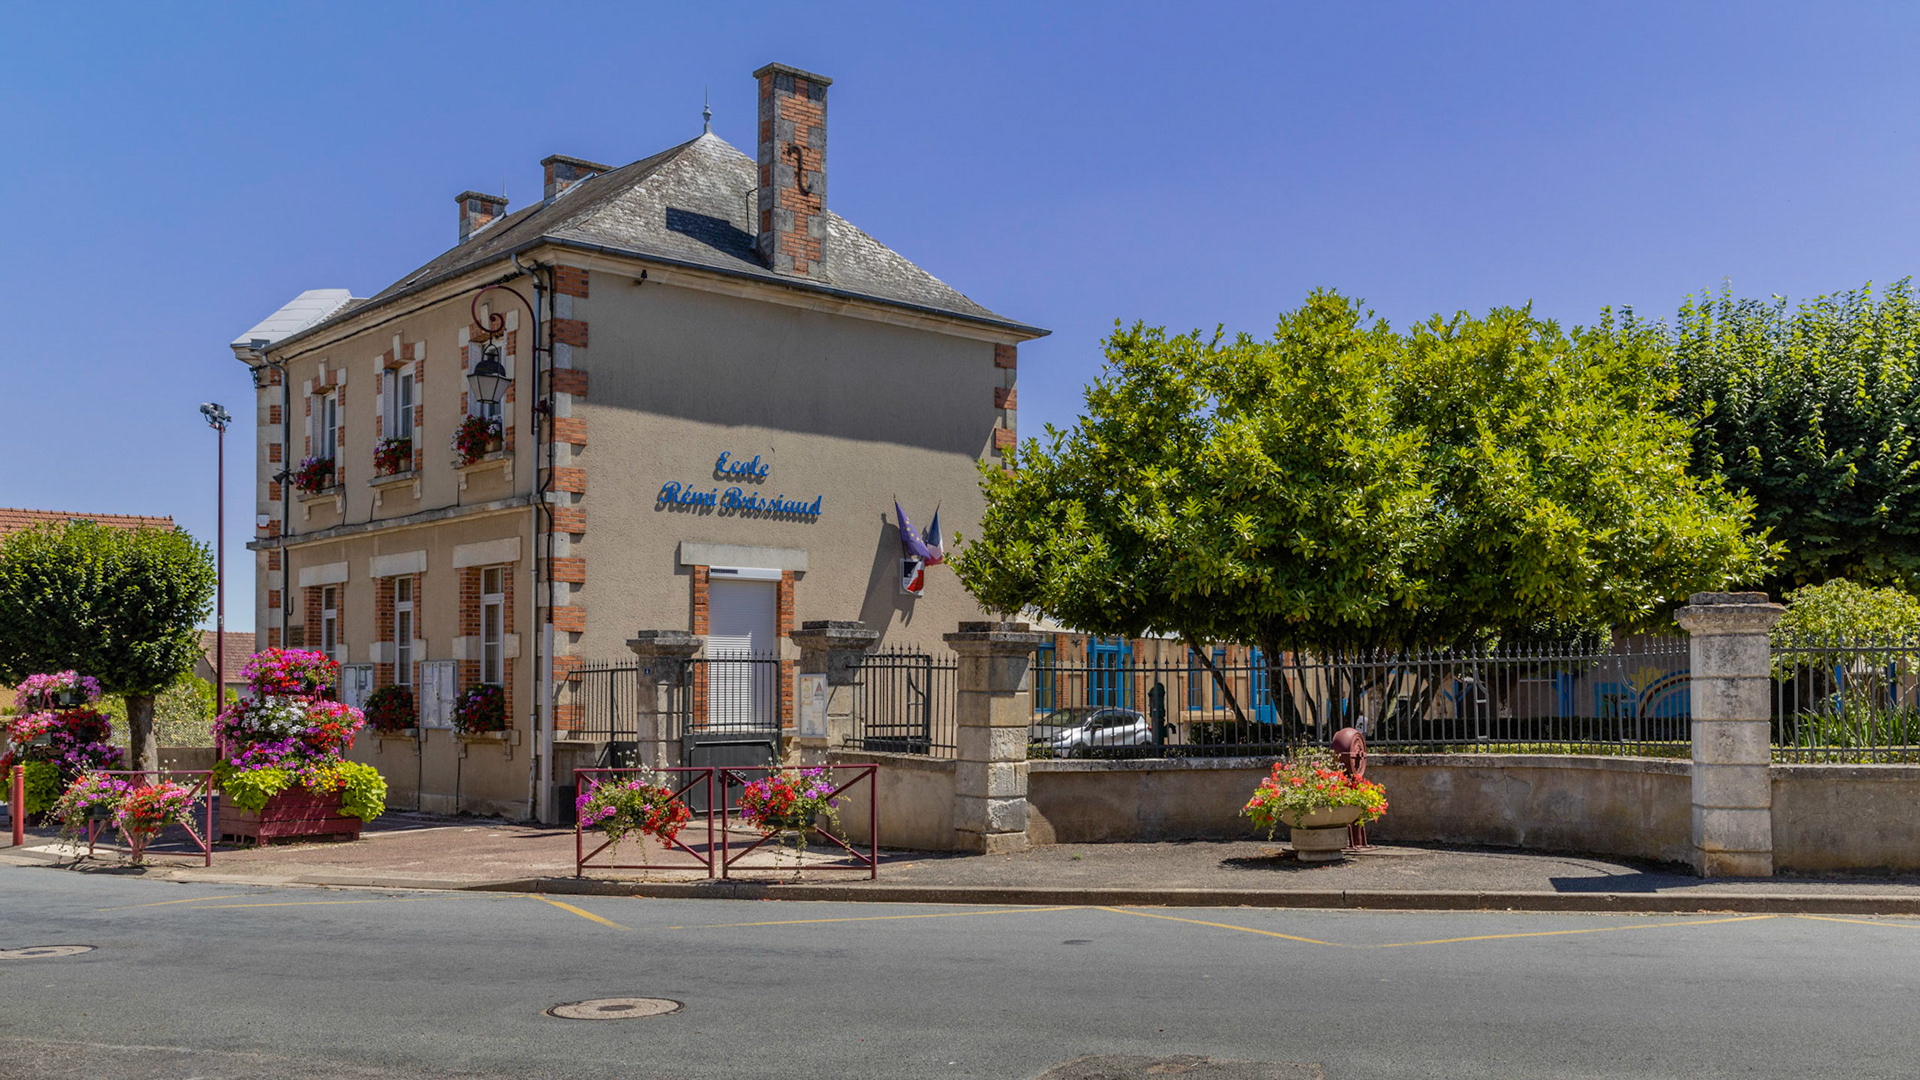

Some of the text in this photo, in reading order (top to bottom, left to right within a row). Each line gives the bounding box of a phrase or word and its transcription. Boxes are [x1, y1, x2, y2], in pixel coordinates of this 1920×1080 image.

[717, 451, 770, 477] Ecole
[659, 481, 823, 516] Rémi Brissiaud
